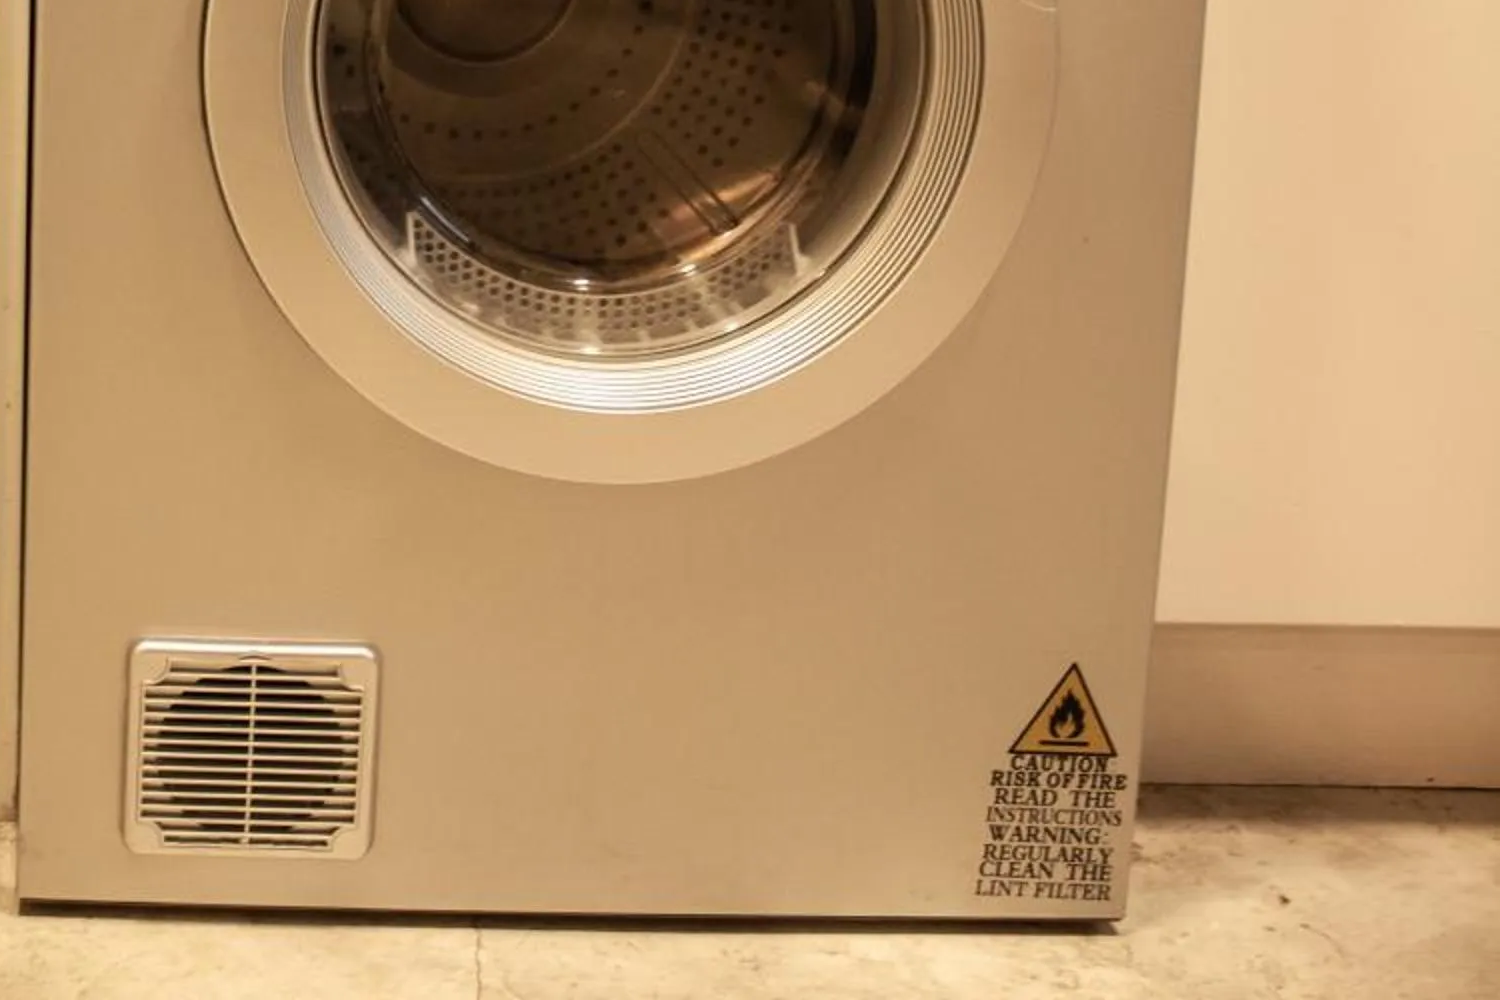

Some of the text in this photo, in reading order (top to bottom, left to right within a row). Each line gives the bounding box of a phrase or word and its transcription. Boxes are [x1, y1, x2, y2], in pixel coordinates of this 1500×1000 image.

[1011, 755, 1108, 772] CAUTION
[991, 770, 1127, 790] RISK OF FIRE
[995, 788, 1116, 808] READ THE
[985, 806, 1122, 826] INSTRUCTIONS
[983, 844, 1113, 863] REGULARLY
[979, 862, 1112, 881] CLEAN THE
[975, 880, 1111, 901] LINT FILTER
